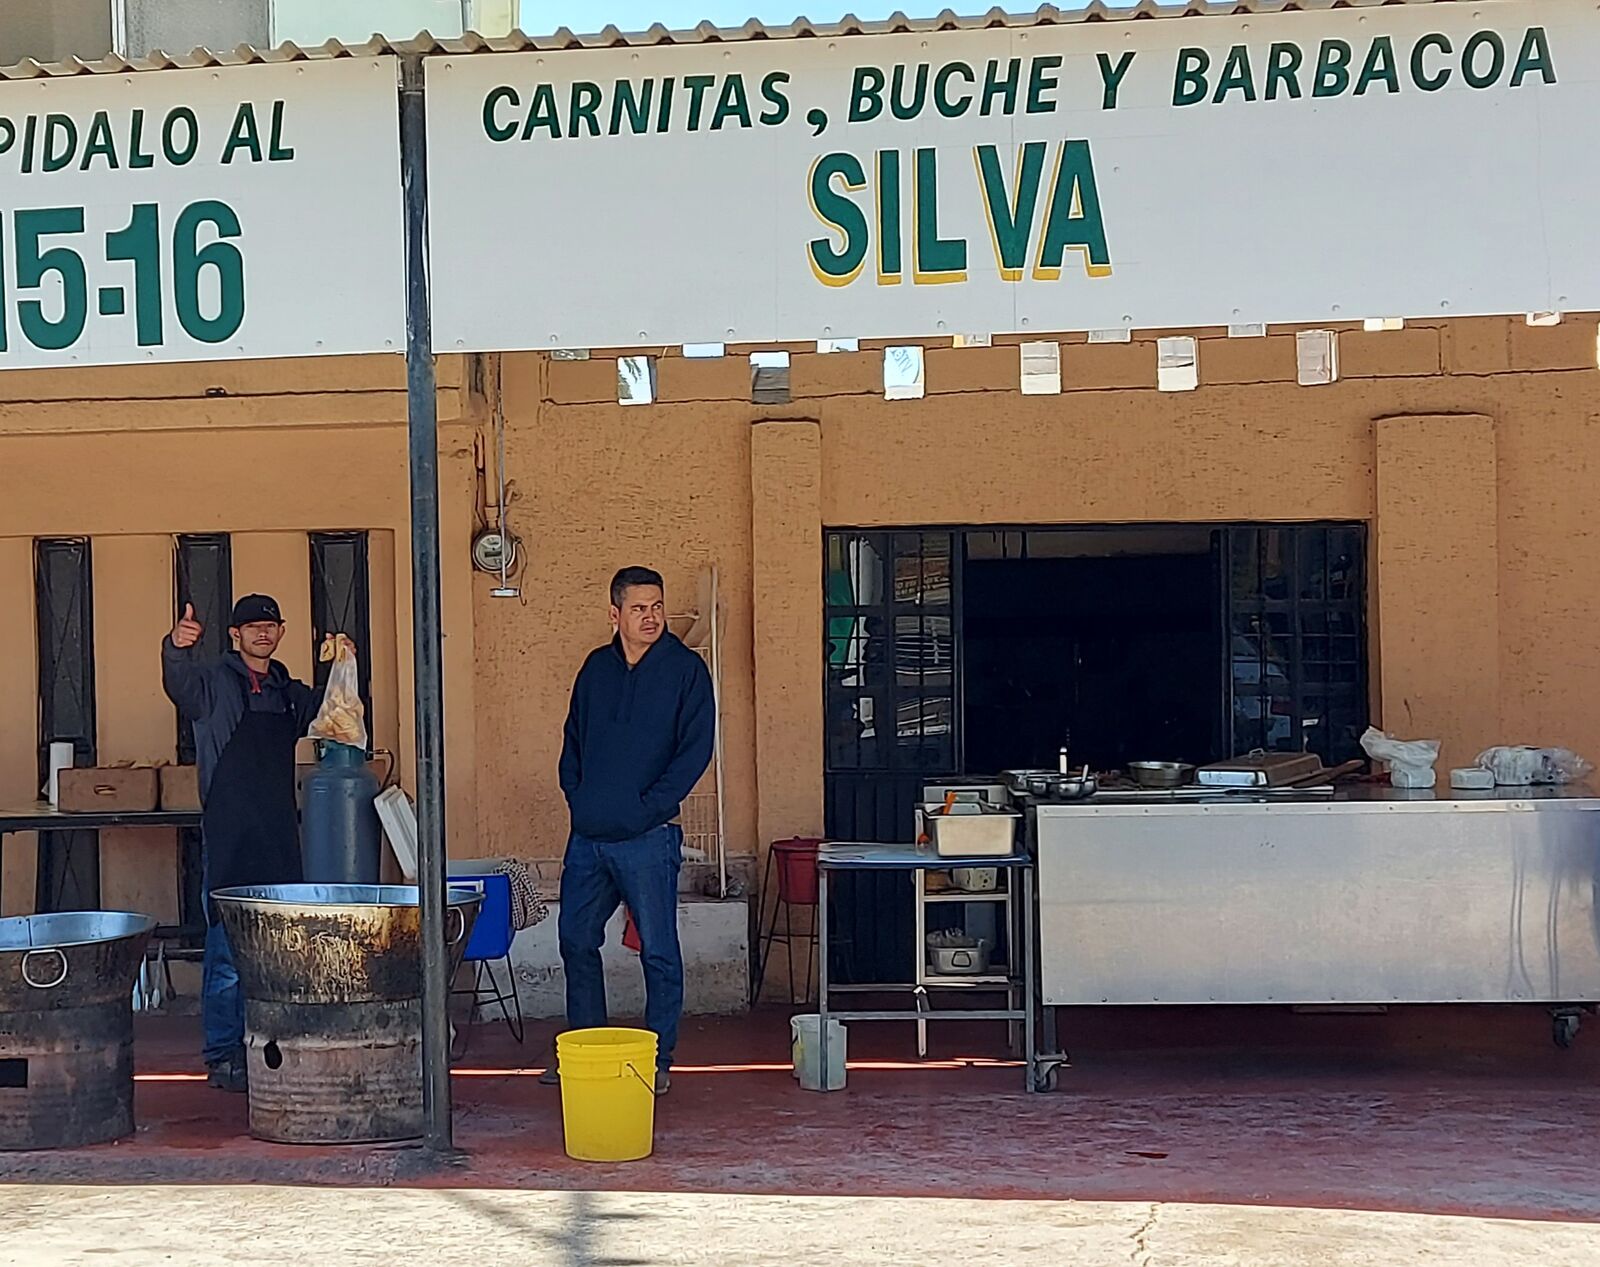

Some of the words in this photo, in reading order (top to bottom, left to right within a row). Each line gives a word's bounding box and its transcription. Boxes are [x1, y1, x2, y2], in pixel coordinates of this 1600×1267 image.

[222, 99, 295, 165] AL
[483, 72, 828, 142] CARNITAS,
[847, 56, 1063, 124] BUCHE
[1098, 52, 1136, 110] Y
[1171, 26, 1557, 107] BARBACOA
[0, 199, 246, 352] 5-16
[806, 138, 1112, 288] SILVA
